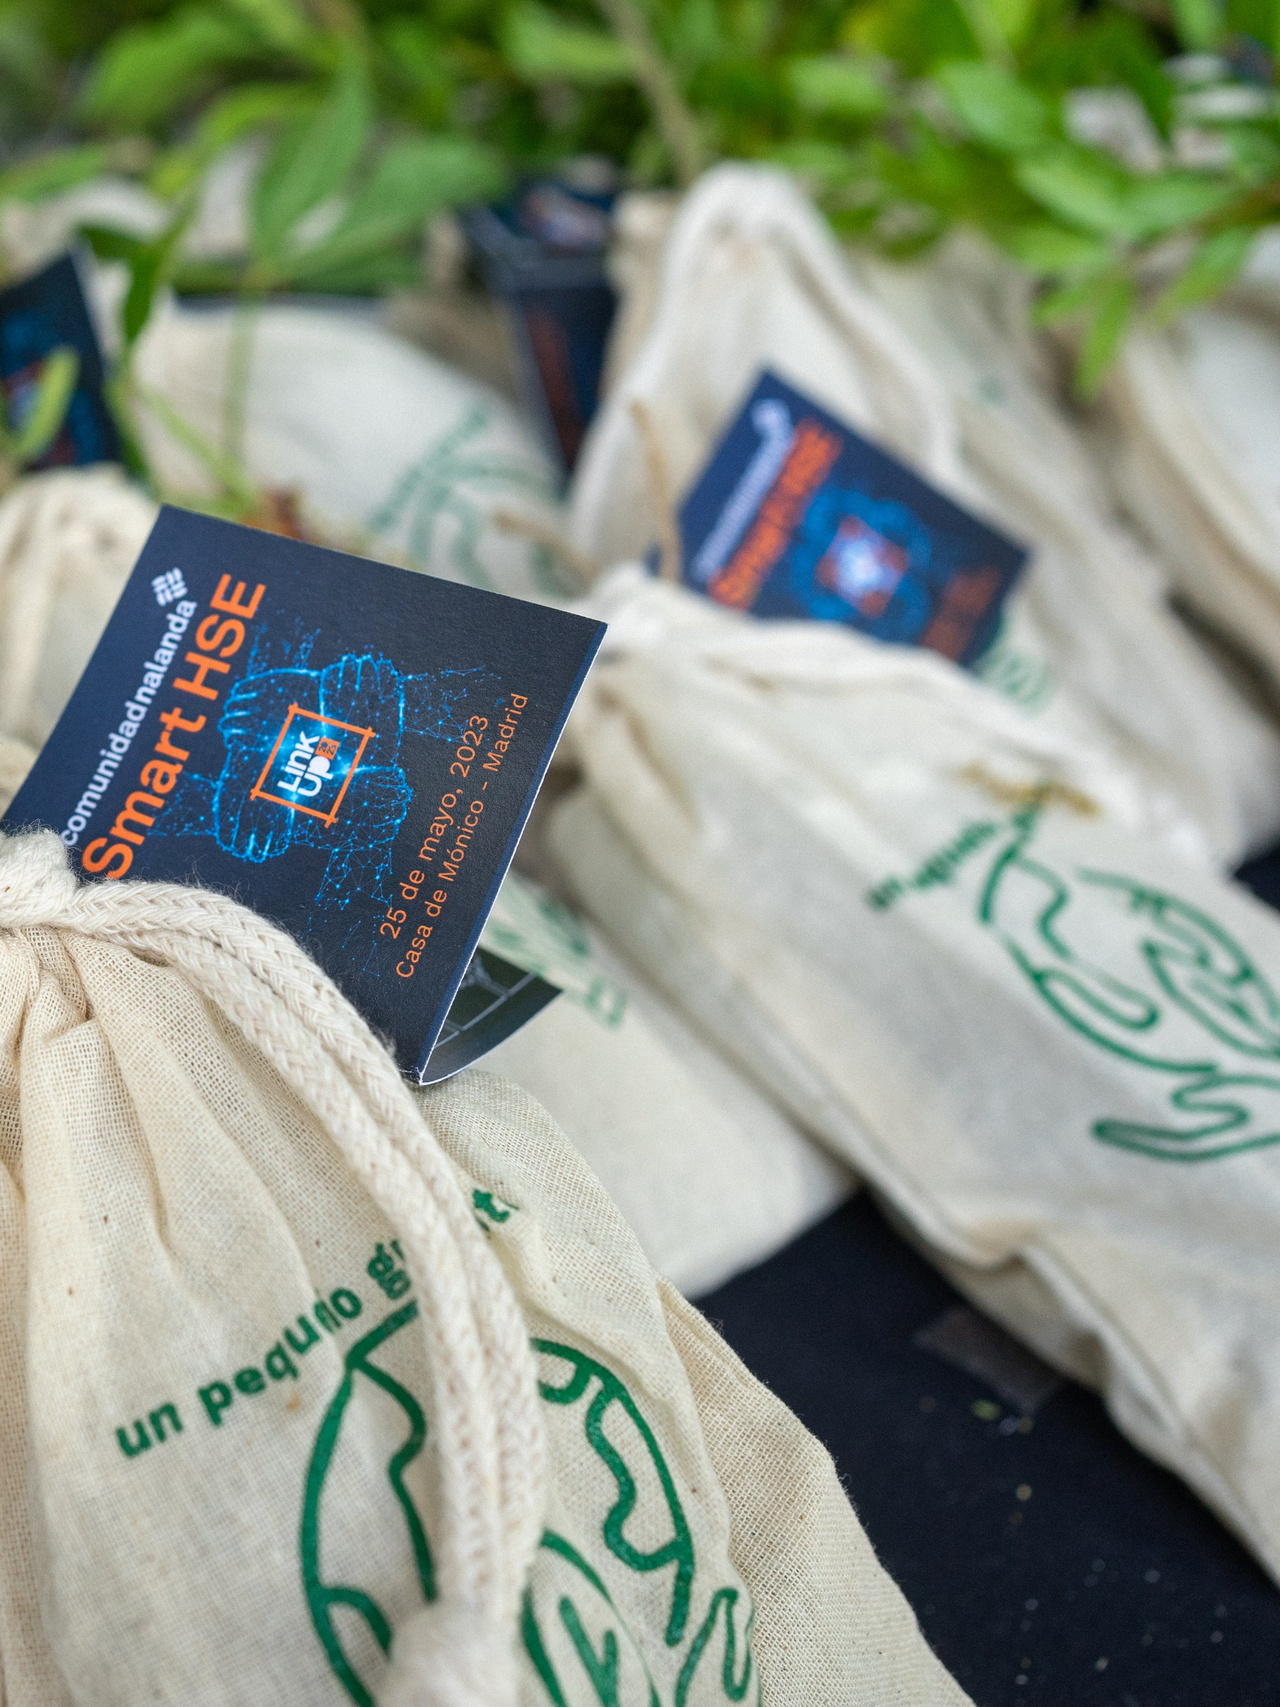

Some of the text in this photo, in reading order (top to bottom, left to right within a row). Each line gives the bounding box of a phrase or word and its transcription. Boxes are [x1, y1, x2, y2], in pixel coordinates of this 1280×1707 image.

[59, 600, 197, 846] comunidadnalanda
[82, 574, 266, 879] Smart HSE
[380, 715, 489, 940] 25 de mayo, 2023
[396, 926, 433, 978] Casa
[425, 890, 448, 918] de
[438, 801, 484, 882] Mónico
[483, 693, 528, 772] Madrid
[115, 1403, 184, 1460] un
